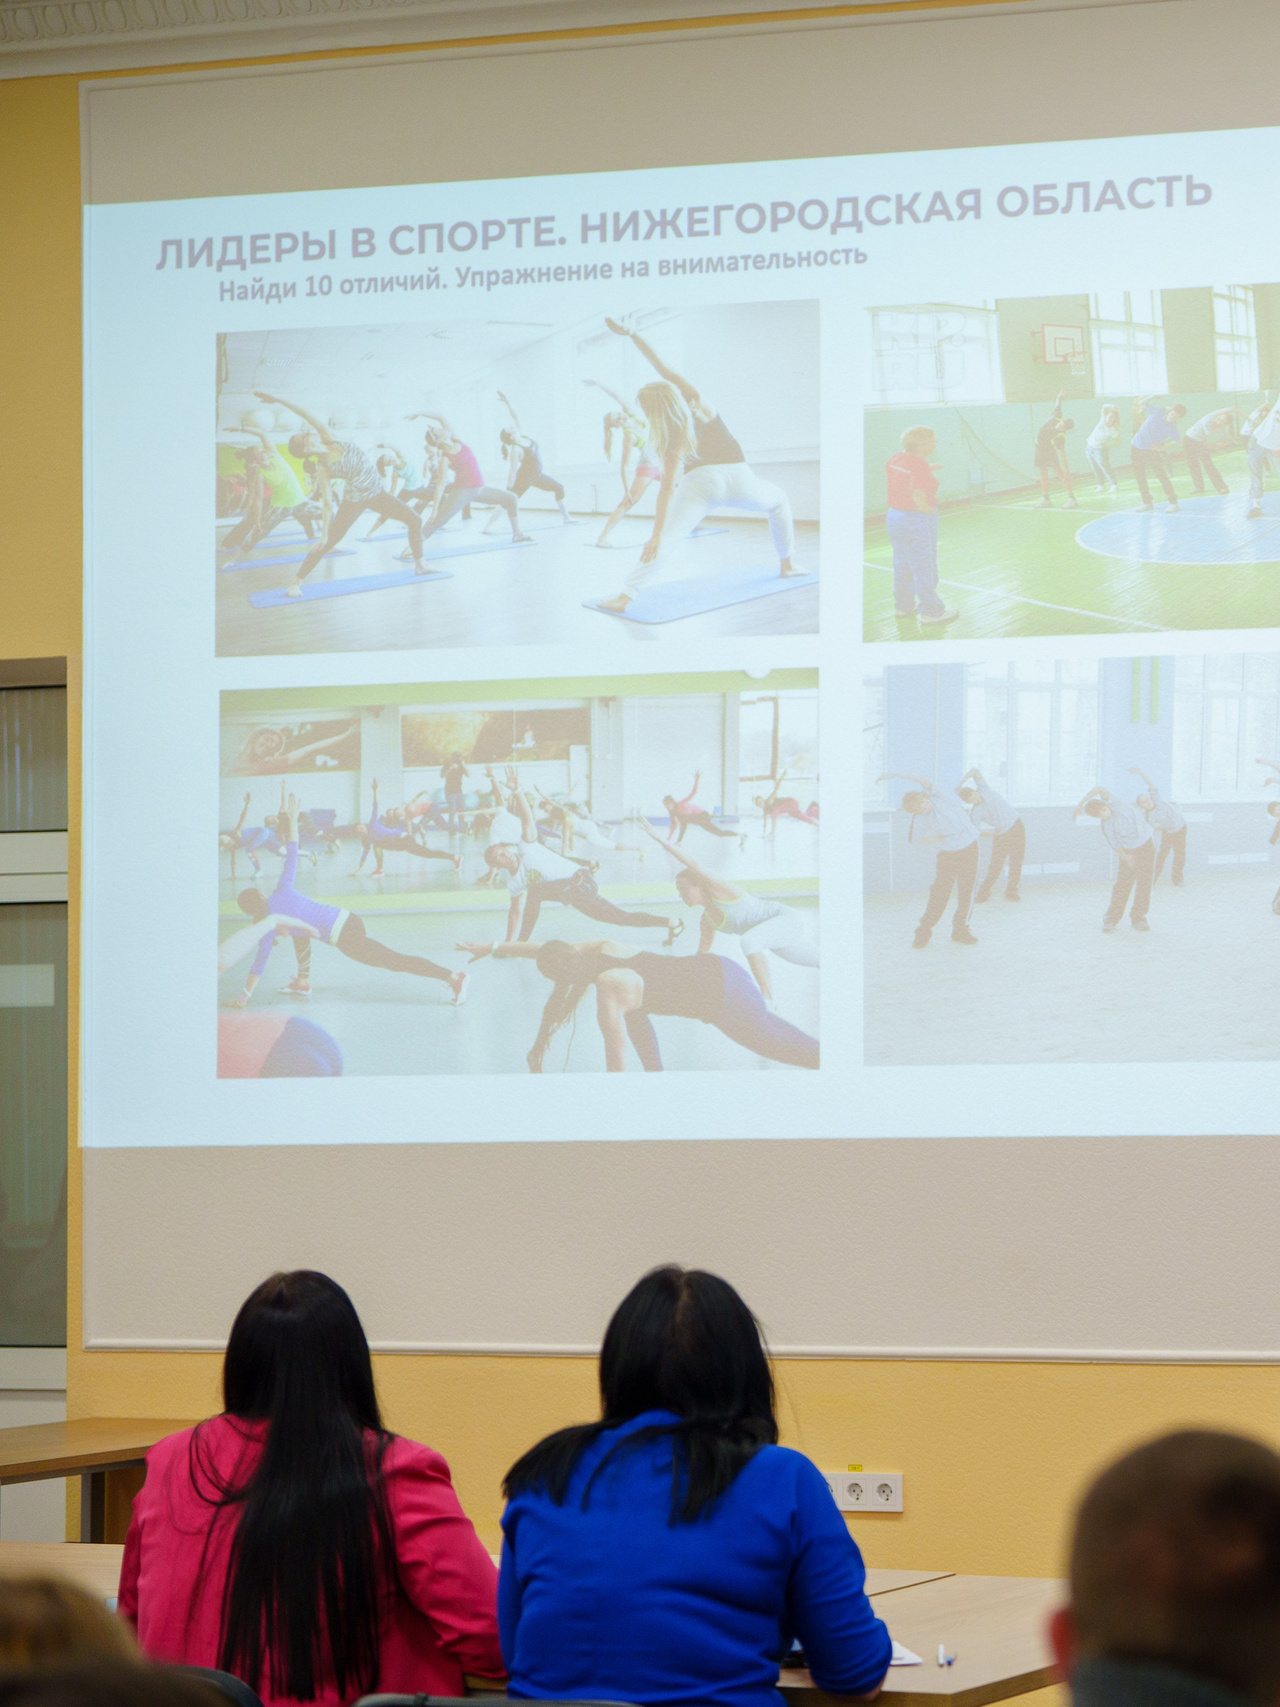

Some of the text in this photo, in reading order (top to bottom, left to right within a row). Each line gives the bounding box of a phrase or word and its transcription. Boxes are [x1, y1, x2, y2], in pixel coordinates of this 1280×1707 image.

[155, 174, 1213, 272] ЛИДЕРЫ В СПОРТЕ. НИЖЕГОРОДСКАЯ ОБЛАСТЬ
[219, 247, 868, 304] Найди 10 отличий. Упражнение на внимательность
